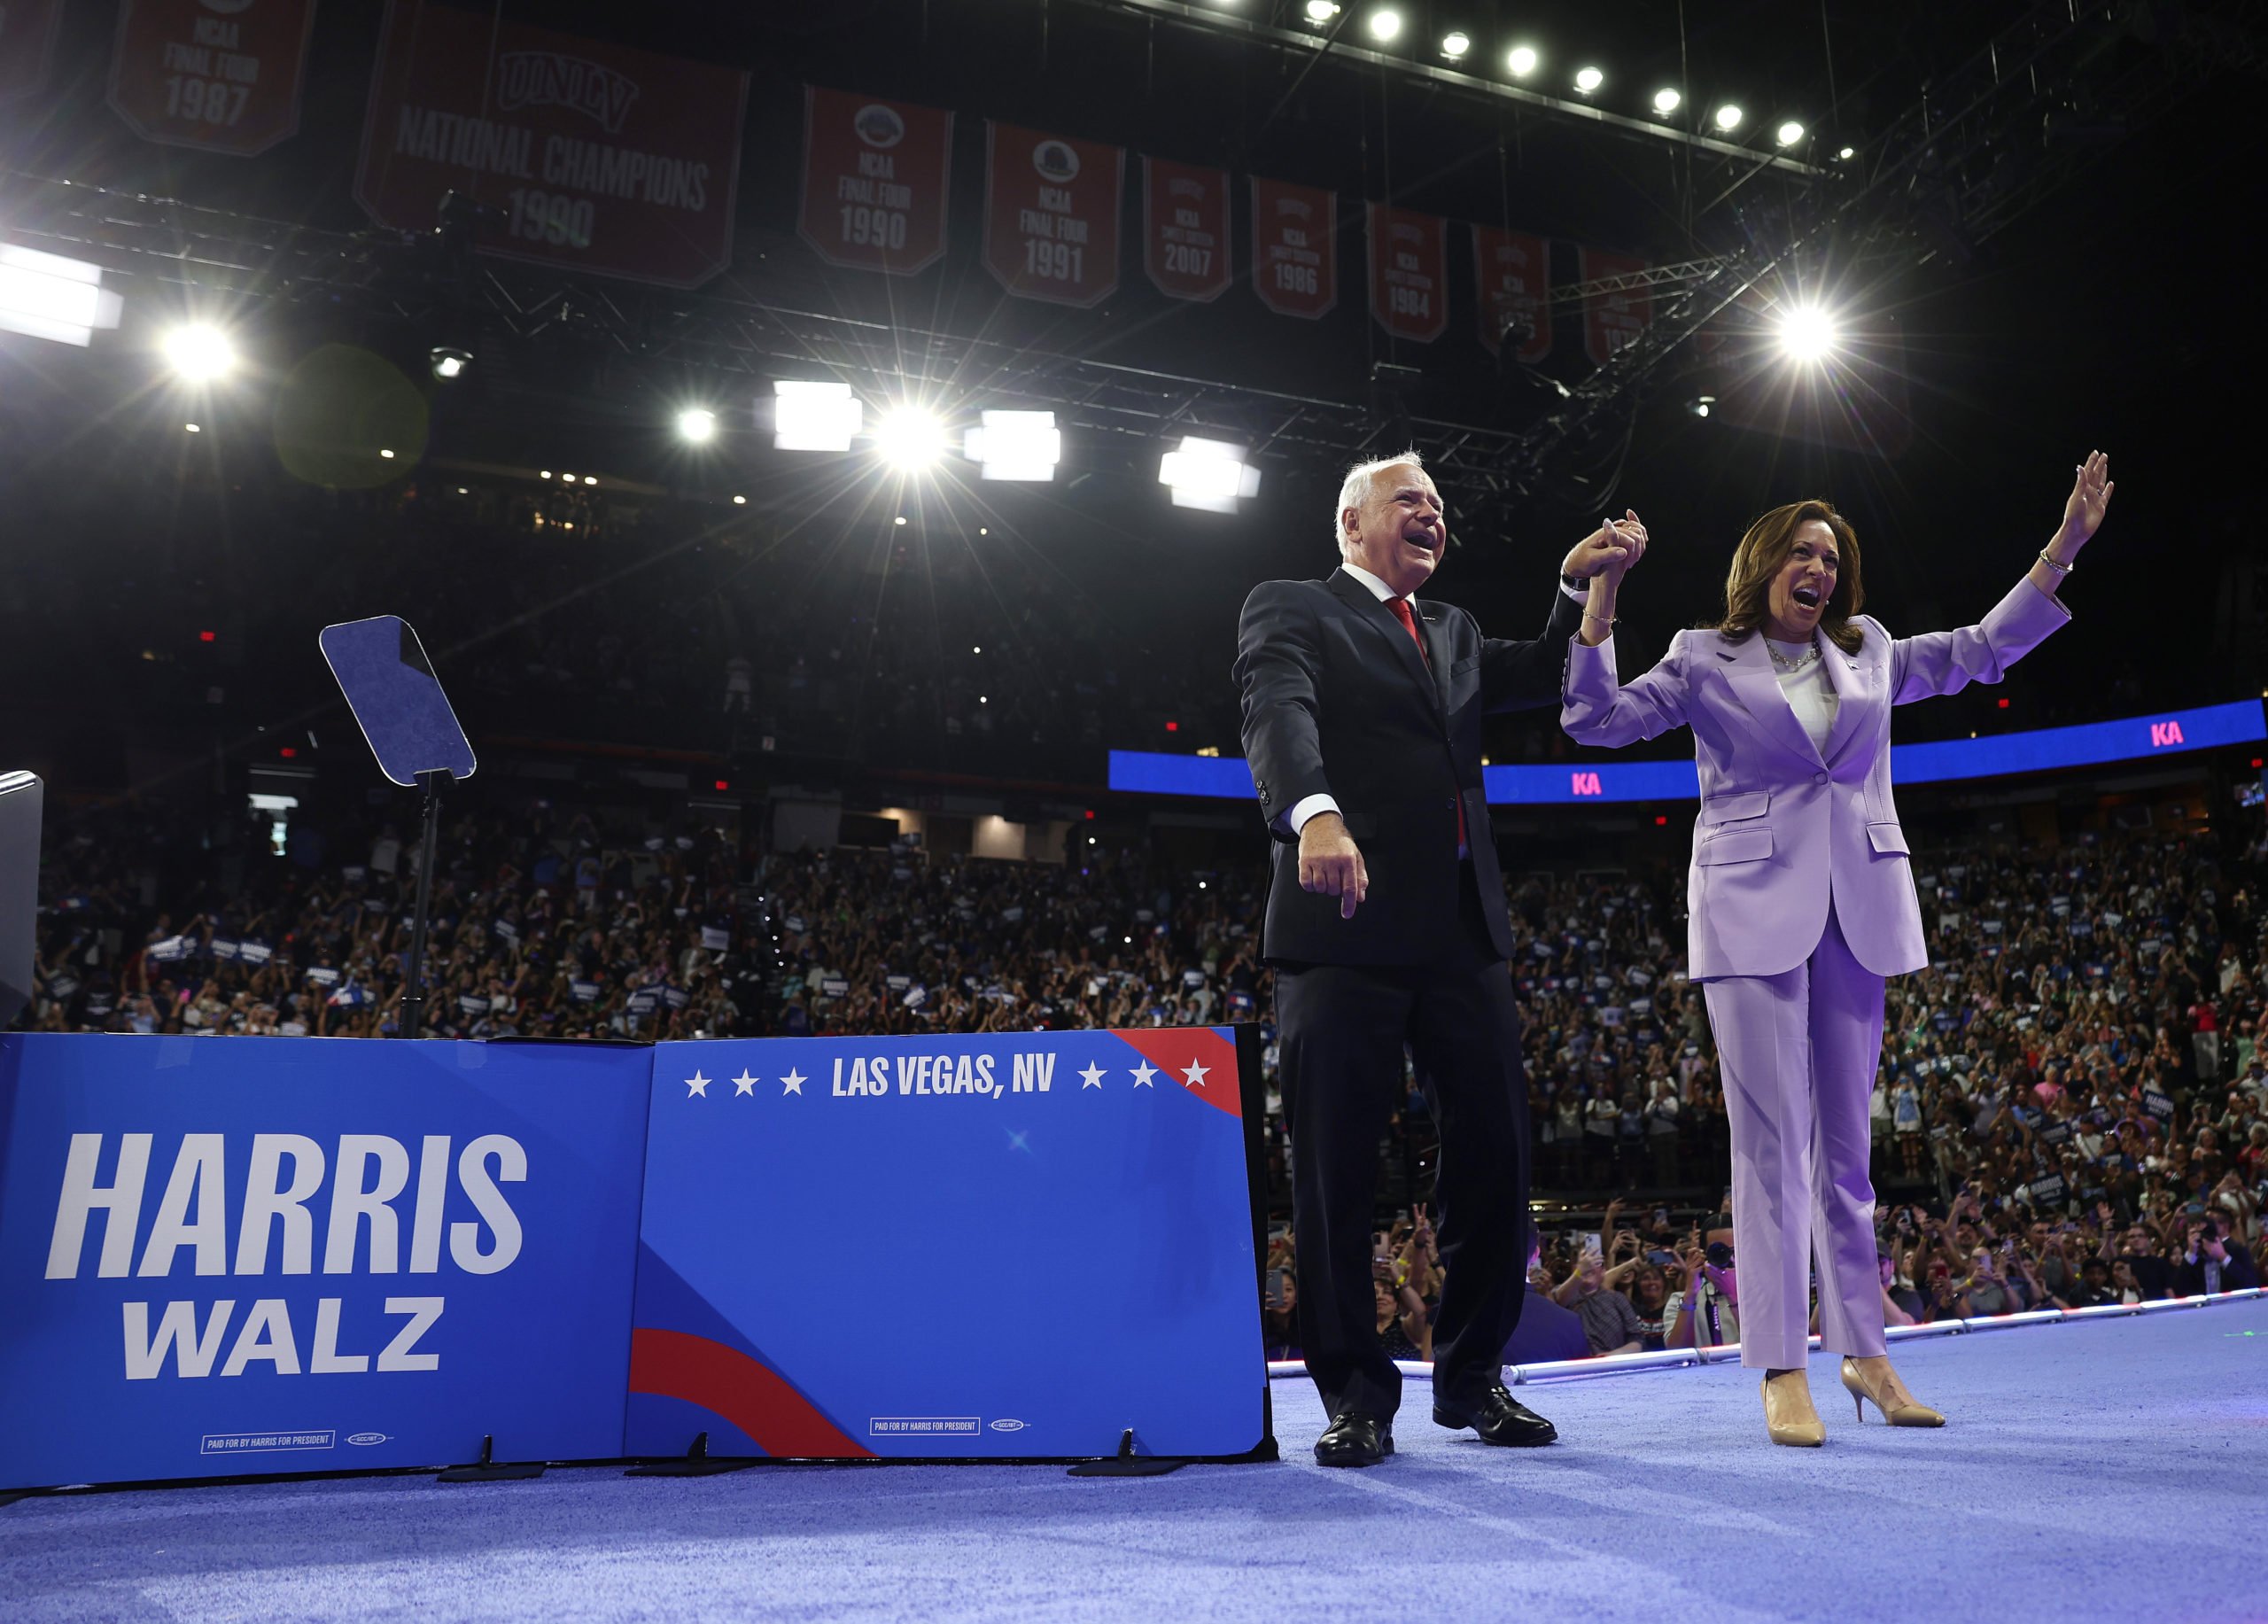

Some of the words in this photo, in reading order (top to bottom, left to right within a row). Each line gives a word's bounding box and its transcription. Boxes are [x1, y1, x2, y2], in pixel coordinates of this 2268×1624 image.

[163, 42, 213, 77] FINAL
[215, 52, 260, 84] FOUR
[166, 75, 252, 127] 1987
[499, 50, 640, 134] UNLV
[395, 104, 532, 178] NATIONAL
[544, 135, 710, 212] CHAMPIONS
[858, 151, 895, 180] NCAA
[837, 175, 874, 204] FINAL
[879, 183, 912, 210] FOUR
[1038, 185, 1072, 214] NCAA
[509, 187, 594, 249] 1990
[840, 205, 906, 250] 1990
[1020, 209, 1053, 238] FINAL
[1058, 216, 1088, 244] FOUR
[1025, 239, 1083, 284] 1991
[1165, 243, 1212, 276] 2007
[1275, 262, 1318, 295] 1986
[1390, 285, 1430, 319] 1984
[2151, 721, 2184, 747] KA
[1572, 772, 1602, 796] KA
[832, 1056, 889, 1097] LAS
[897, 1053, 1005, 1100] VEGAS,
[1012, 1053, 1057, 1092] NV
[44, 1133, 528, 1280] HARRIS
[122, 1296, 446, 1380] WALZ
[207, 1440, 224, 1449] PAID
[225, 1439, 239, 1448] FOR
[240, 1438, 250, 1448] BY
[251, 1437, 277, 1447] HARRIS
[278, 1436, 291, 1446] FOR
[292, 1434, 330, 1445] PRESIDENT
[874, 1421, 889, 1431] PAID
[889, 1421, 900, 1431] FOR
[901, 1421, 909, 1431] BY
[910, 1421, 932, 1431] HARRIS
[932, 1421, 944, 1431] FOR
[944, 1421, 975, 1431] PRESIDENT
